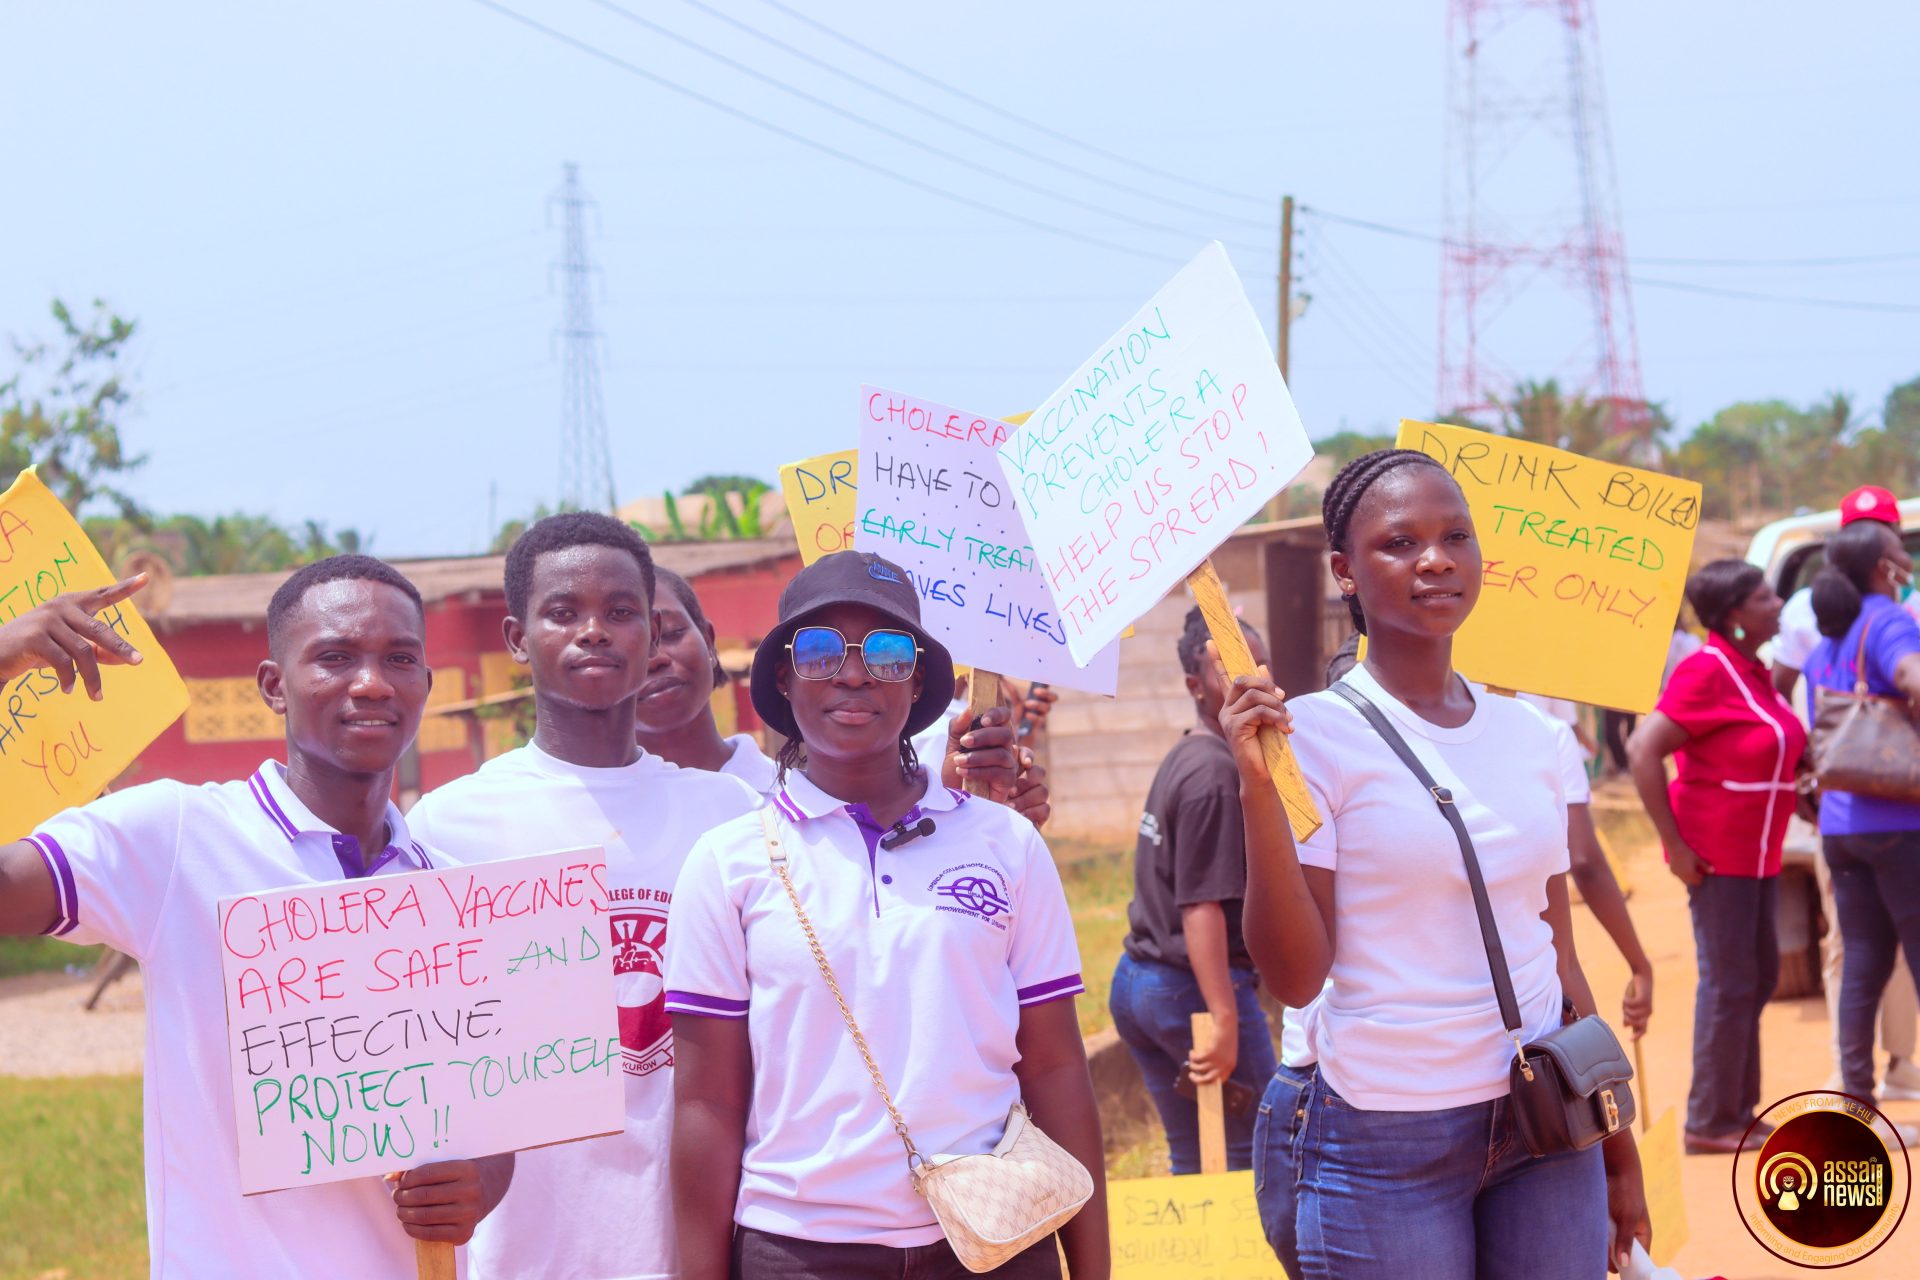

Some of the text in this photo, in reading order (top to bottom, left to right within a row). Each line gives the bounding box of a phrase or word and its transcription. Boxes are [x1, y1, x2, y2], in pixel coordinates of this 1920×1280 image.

[868, 393, 1007, 447] CHOLERA
[997, 307, 1170, 475] VACCINATION
[875, 451, 952, 496] HAVE
[1022, 368, 1166, 519] PREVENTS
[1080, 369, 1223, 514] CHOLERA
[1421, 430, 1580, 509] DRINK
[796, 460, 858, 505] DR
[1046, 383, 1247, 592] HELP US STOP
[861, 508, 1034, 573] EARLY TREAT
[1493, 505, 1664, 571] TREATED
[0, 541, 79, 625] TION
[1062, 567, 1120, 635] THE
[1482, 560, 1538, 599] ER
[985, 593, 1067, 645] LIVES
[22, 720, 104, 796] YOU
[224, 863, 610, 959] CHOLERA VACCINES
[609, 888, 635, 902] LEGE
[638, 888, 652, 901] OF
[238, 957, 345, 1014] ARE
[506, 926, 601, 975] AND
[253, 1062, 435, 1136] PROTECT
